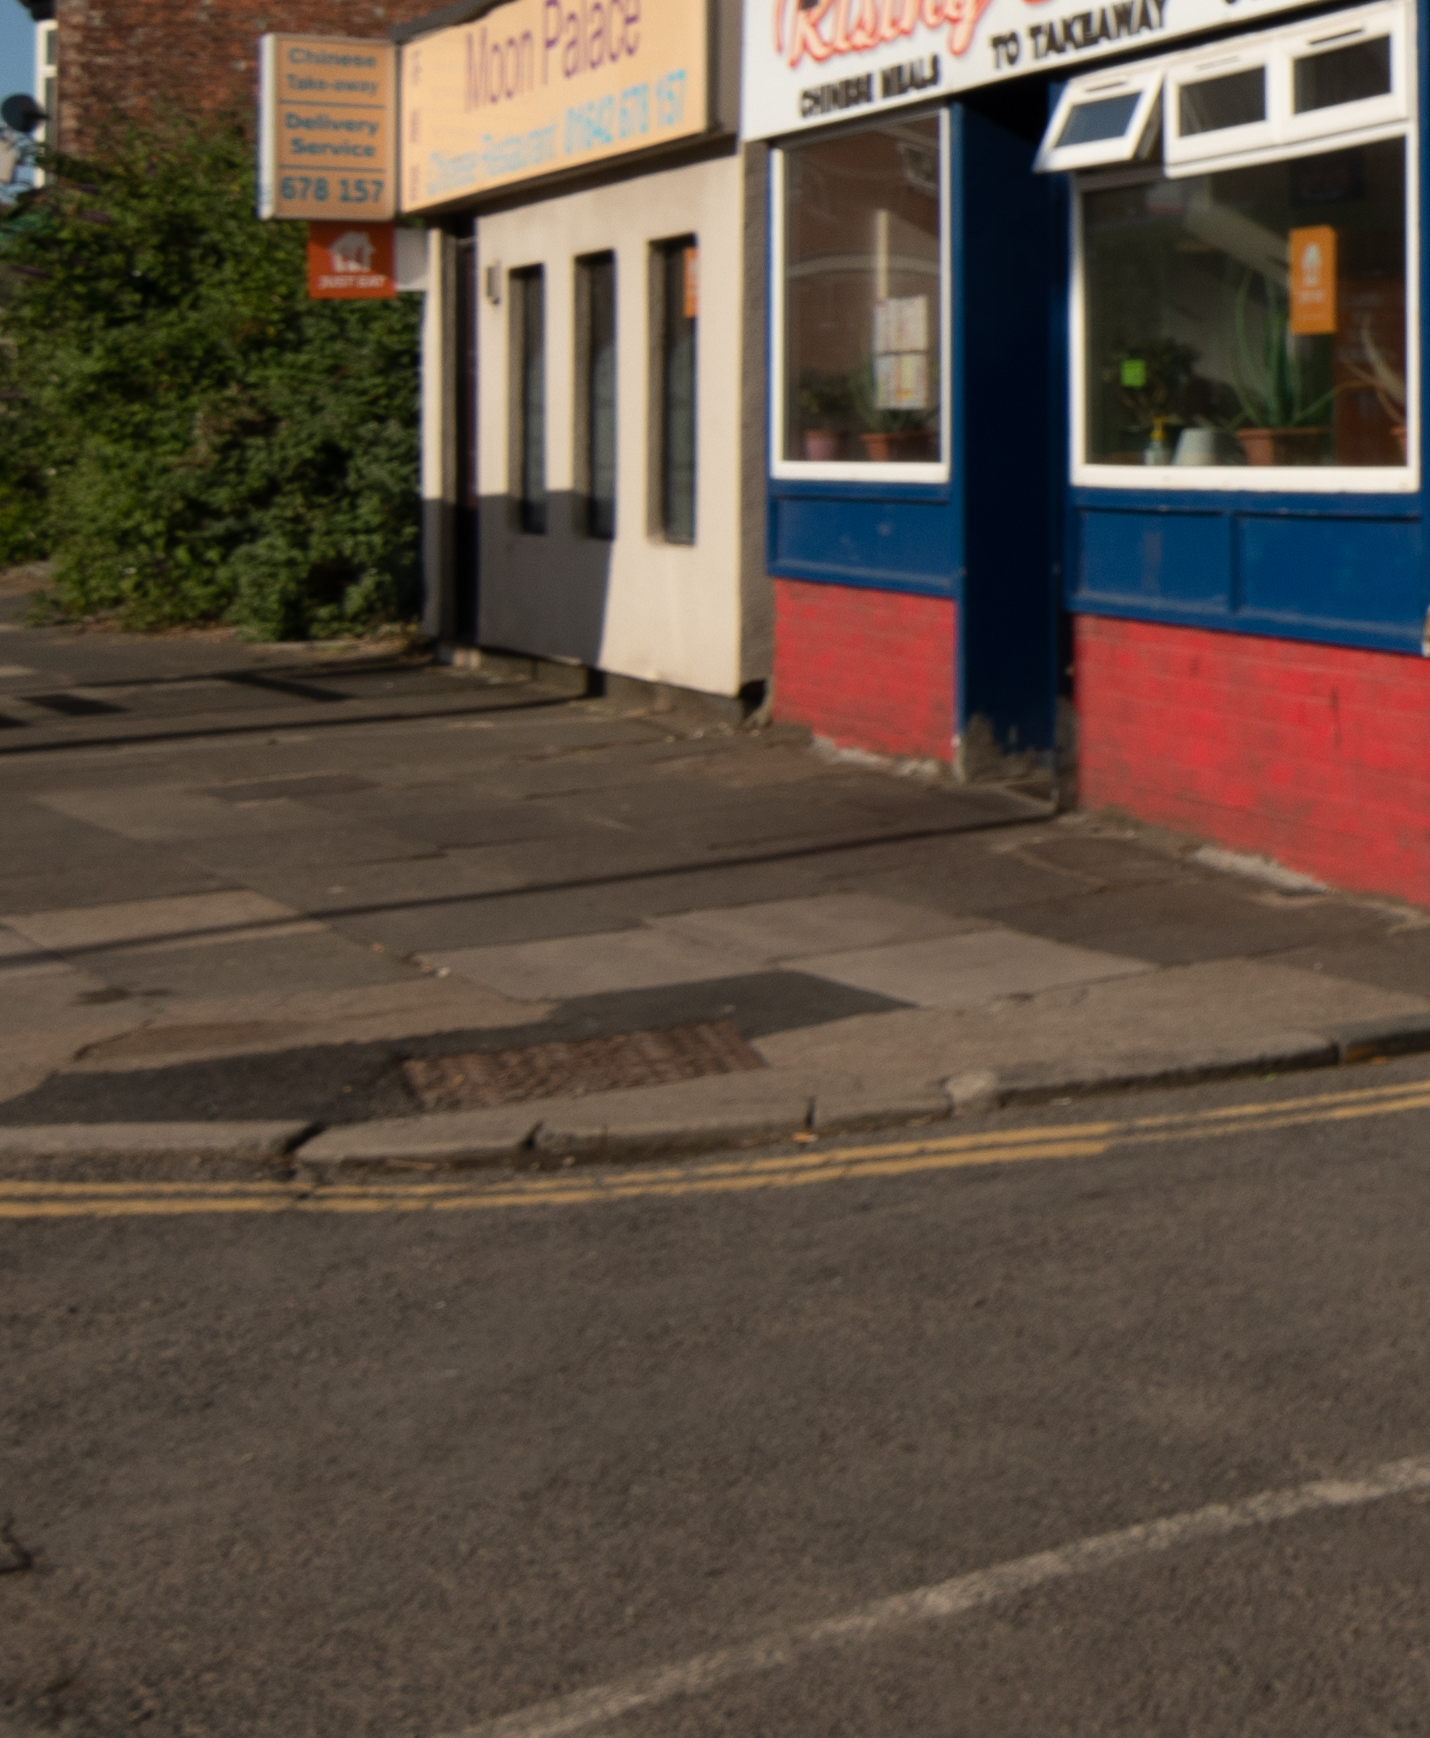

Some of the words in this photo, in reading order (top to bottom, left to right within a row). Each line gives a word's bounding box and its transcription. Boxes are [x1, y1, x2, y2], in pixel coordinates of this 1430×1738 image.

[990, 32, 1019, 69] TO
[465, 27, 534, 111] Moon
[801, 70, 873, 118] CHINESE
[284, 113, 378, 136] Delivery
[290, 138, 375, 157] Service
[280, 176, 329, 202] 678
[339, 179, 385, 203] 157
